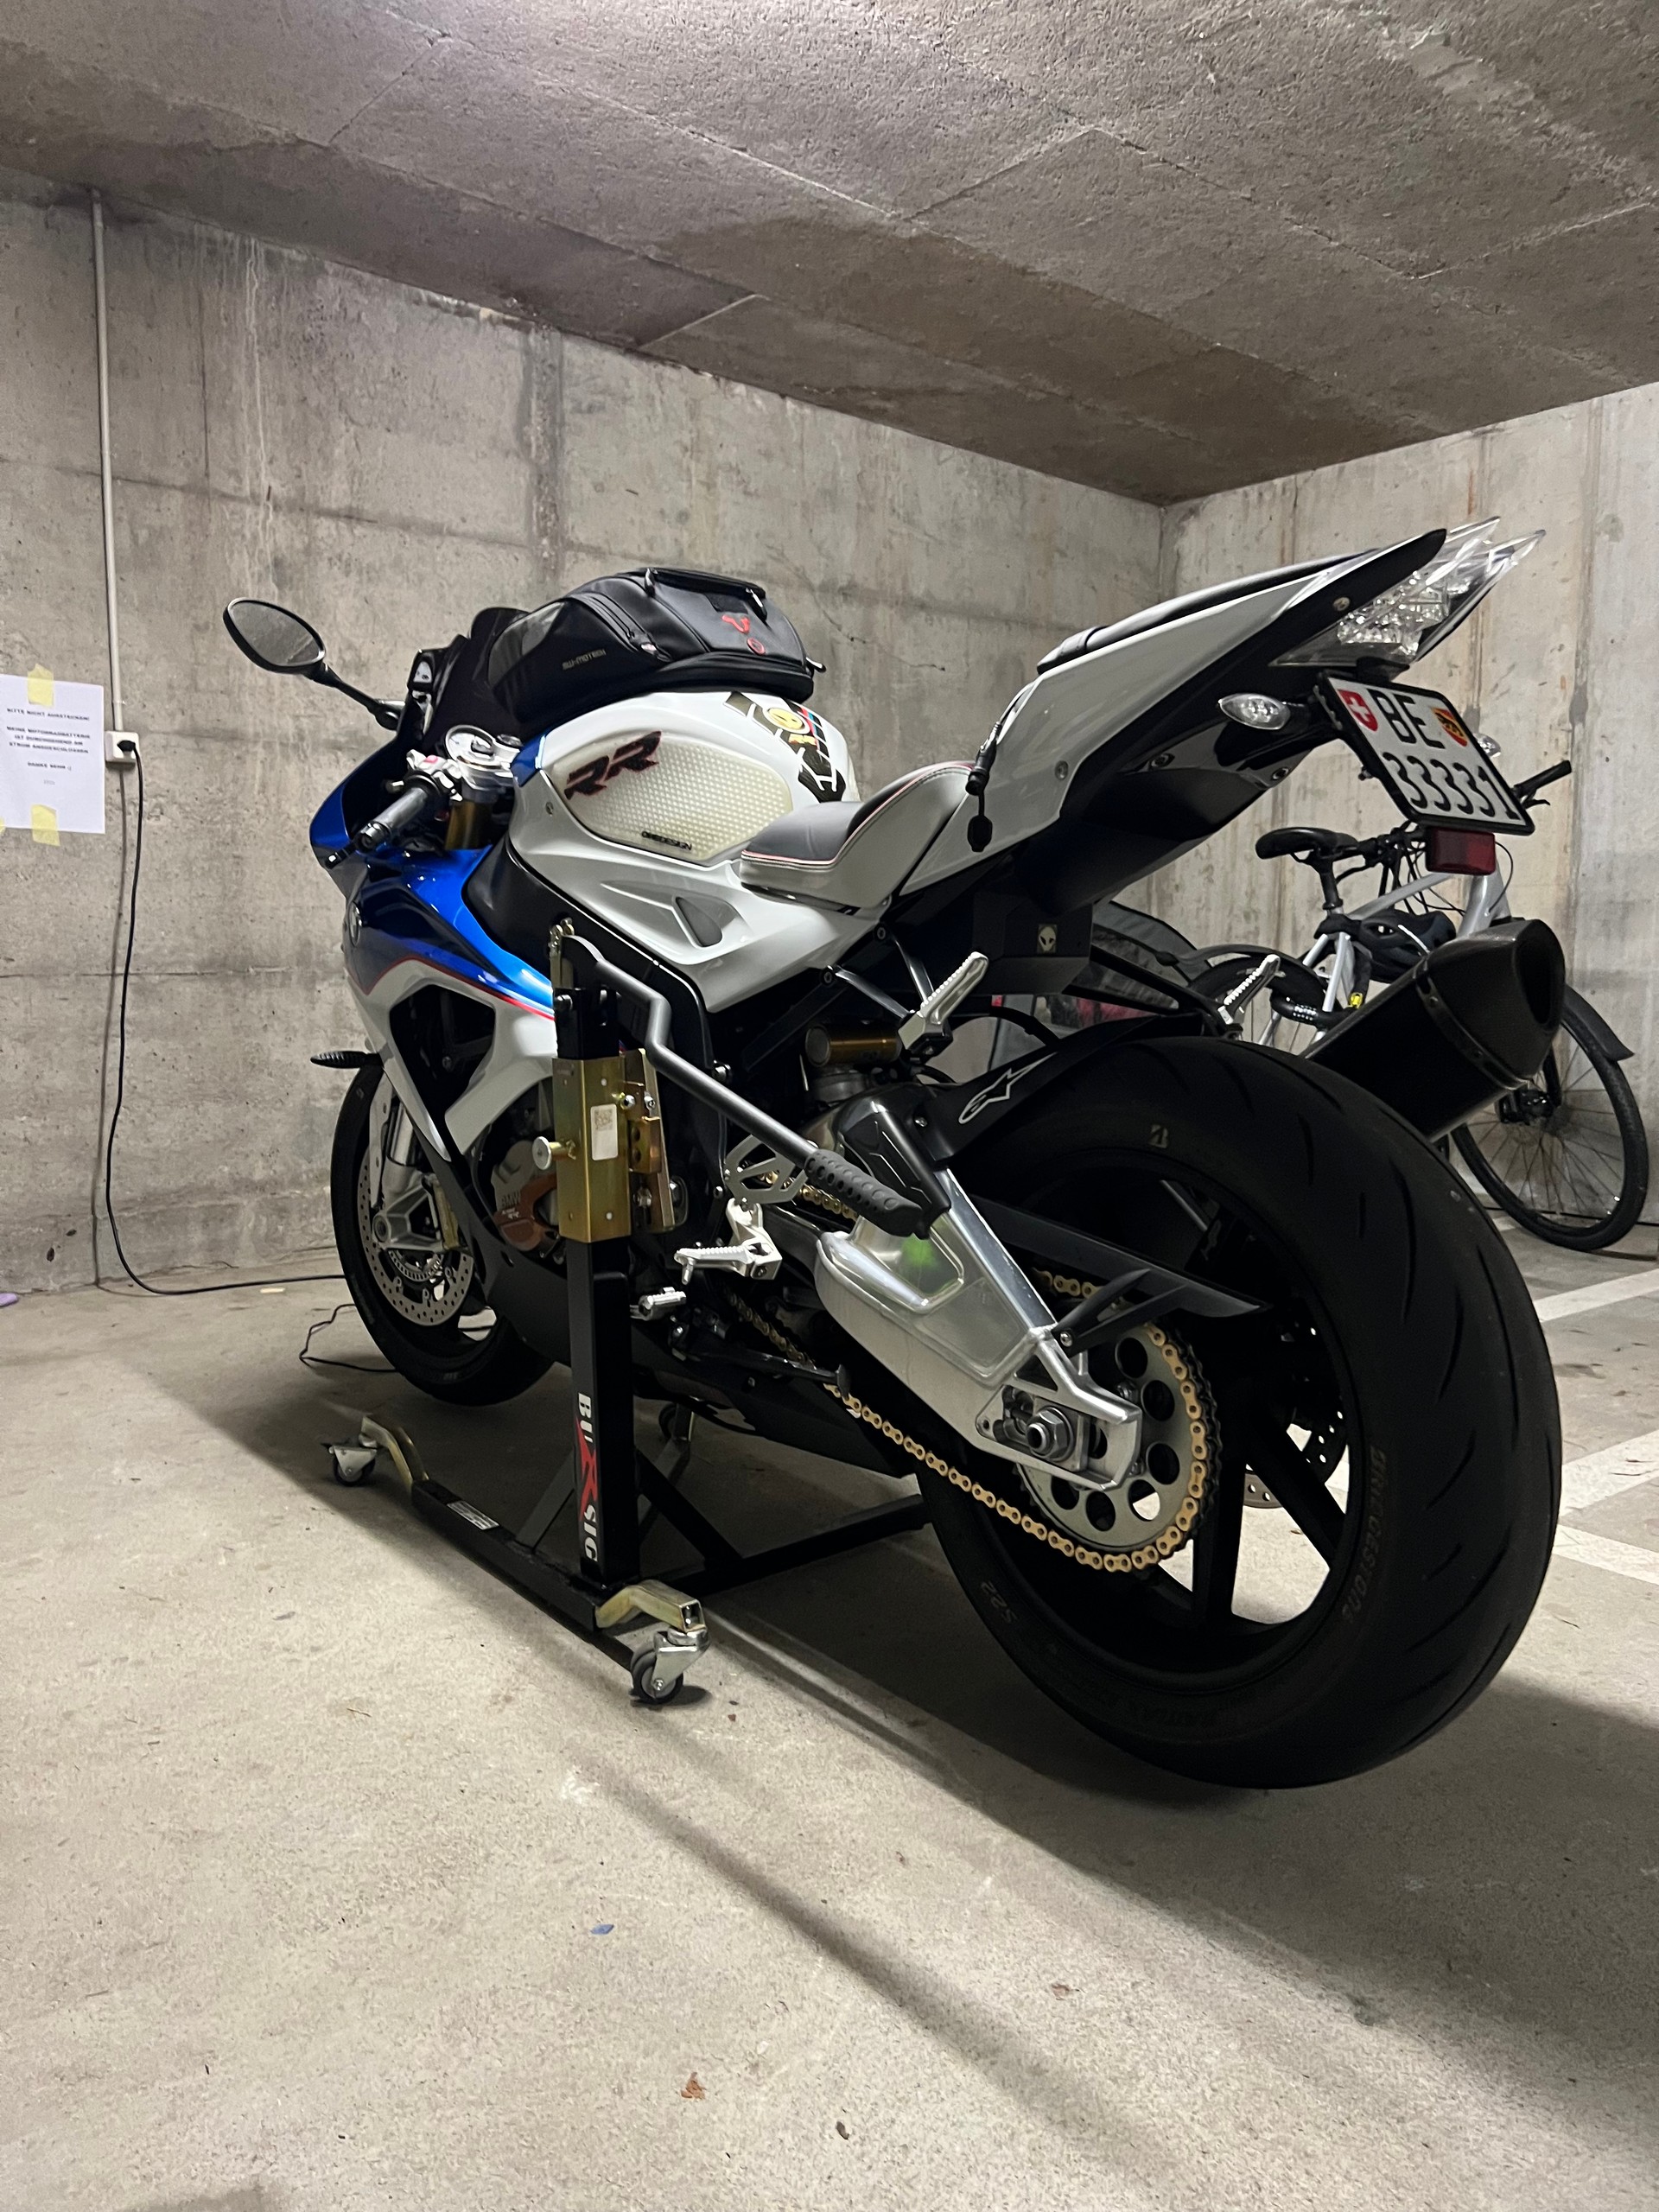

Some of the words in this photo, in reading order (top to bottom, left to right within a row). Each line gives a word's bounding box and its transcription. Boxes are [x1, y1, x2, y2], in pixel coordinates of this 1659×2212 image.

[562, 648, 607, 671] SW-MOTECH
[1367, 689, 1446, 749] BE
[564, 730, 662, 800] RR
[1382, 752, 1520, 820] 33331
[501, 1190, 521, 1207] BMW
